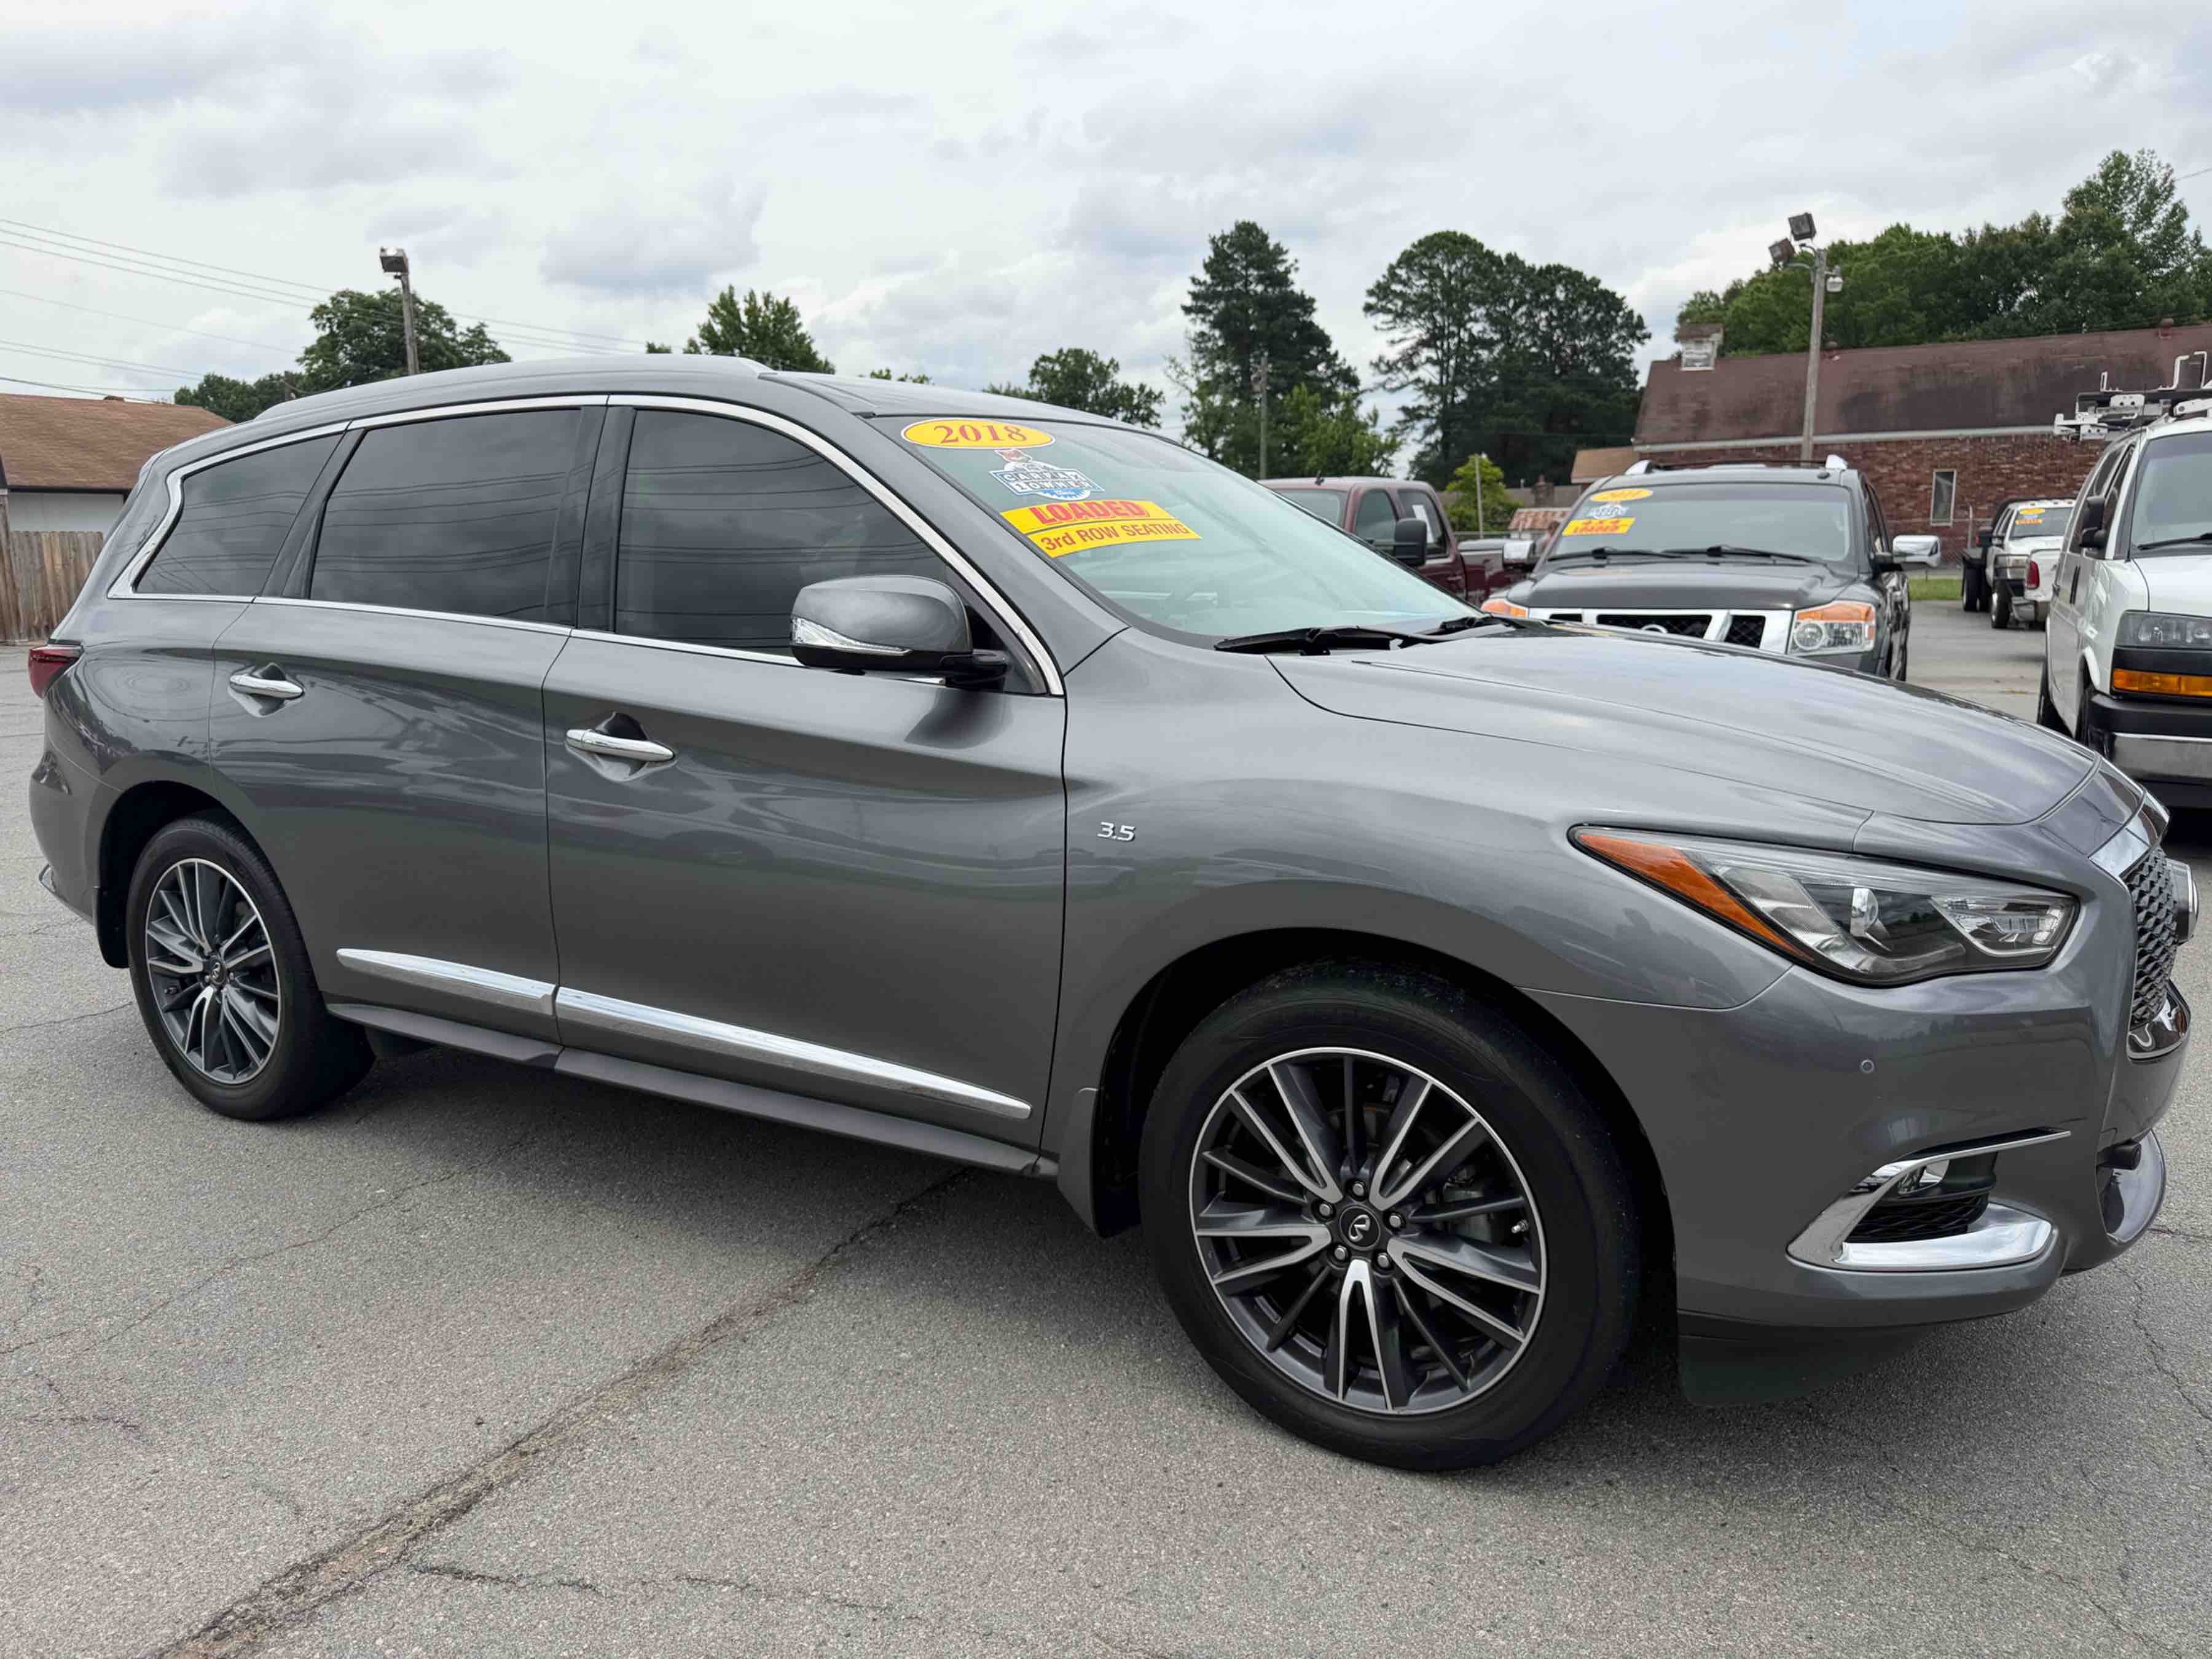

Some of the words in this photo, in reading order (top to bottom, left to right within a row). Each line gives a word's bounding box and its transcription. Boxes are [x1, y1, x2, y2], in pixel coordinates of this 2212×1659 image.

[933, 424, 1028, 444] 2018
[1003, 471, 1086, 481] CARFAX
[1029, 480, 1093, 489] OWNER
[1029, 501, 1151, 525] LOADED
[1040, 532, 1076, 551] 3rd
[1076, 525, 1120, 543] ROW
[1120, 523, 1190, 537] SEATING
[1097, 822, 1135, 841] 3.5
